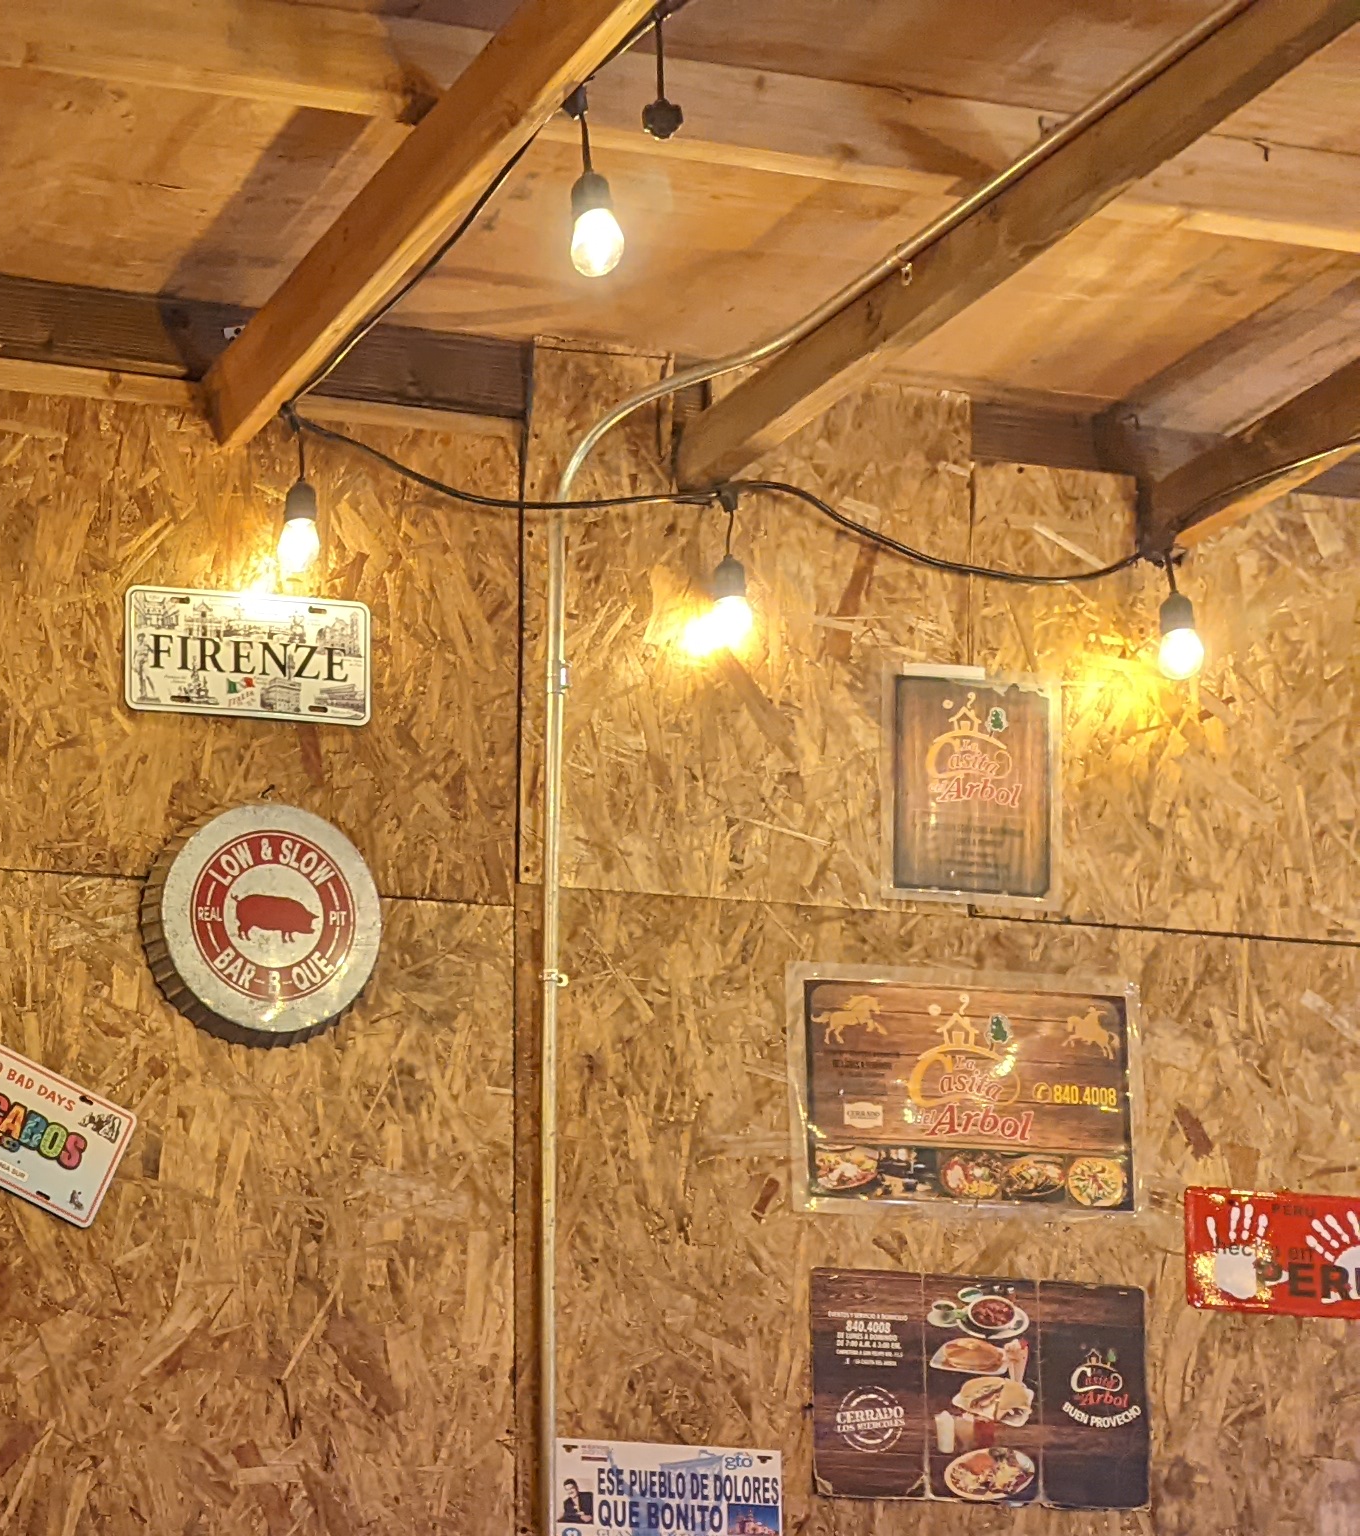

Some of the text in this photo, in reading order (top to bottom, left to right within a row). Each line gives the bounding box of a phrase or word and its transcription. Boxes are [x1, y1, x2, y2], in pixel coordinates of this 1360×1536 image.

[149, 632, 349, 683] FIRENZE
[936, 775, 1023, 809] Arbol
[208, 837, 336, 887] LOW & SLOW
[197, 906, 223, 922] REAL
[329, 910, 348, 926] PIT
[6, 1068, 35, 1091] BAD
[36, 1083, 78, 1113] DAYS
[908, 1049, 1021, 1108] Casita
[1053, 1084, 1118, 1107] 840.4008
[926, 1101, 1035, 1143] Arbol
[10, 1168, 27, 1180] SUR
[1271, 1204, 1317, 1218] PERU
[1256, 1261, 1360, 1301] PER
[845, 1320, 892, 1334] 840.4008
[835, 1405, 905, 1424] CERRADO
[1062, 1401, 1142, 1429] BUEN PROVECHO
[1079, 1391, 1130, 1409] Arbol
[597, 1467, 780, 1505] ESE PUEBLO DE DOLORES
[597, 1499, 724, 1533] QUE BONITO
